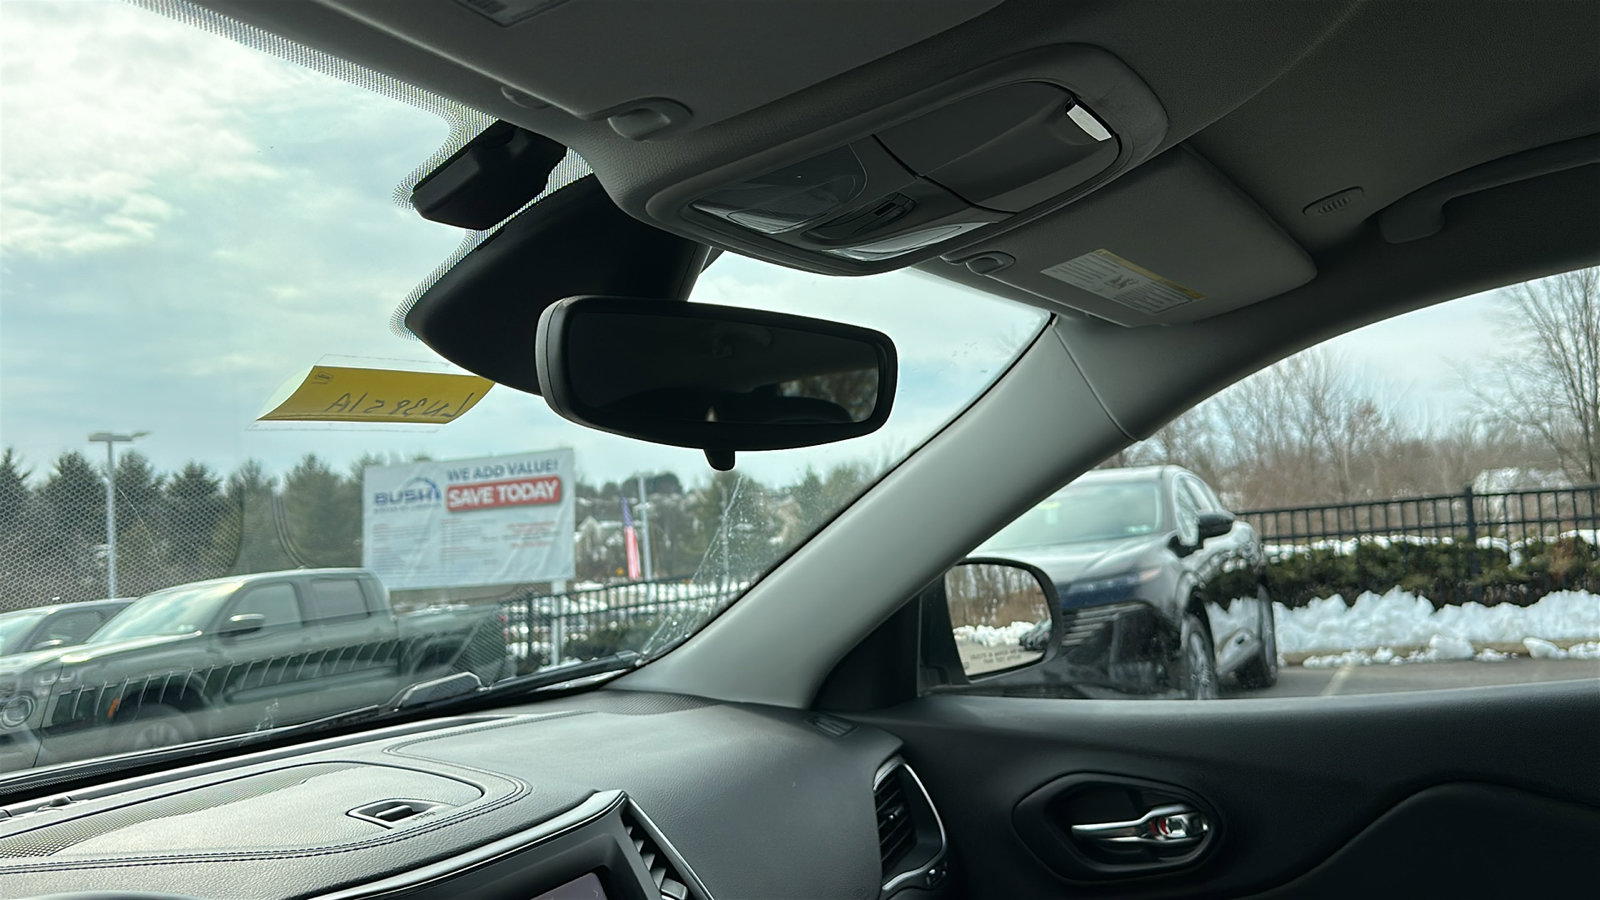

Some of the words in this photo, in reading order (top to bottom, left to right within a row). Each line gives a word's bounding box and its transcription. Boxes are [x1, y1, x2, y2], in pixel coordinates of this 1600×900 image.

[447, 469, 470, 482] WE
[473, 465, 506, 480] ADD
[508, 459, 559, 477] VALUE!
[374, 488, 434, 506] BUSH
[448, 486, 495, 507] SAVE
[496, 480, 558, 502] TODAY
